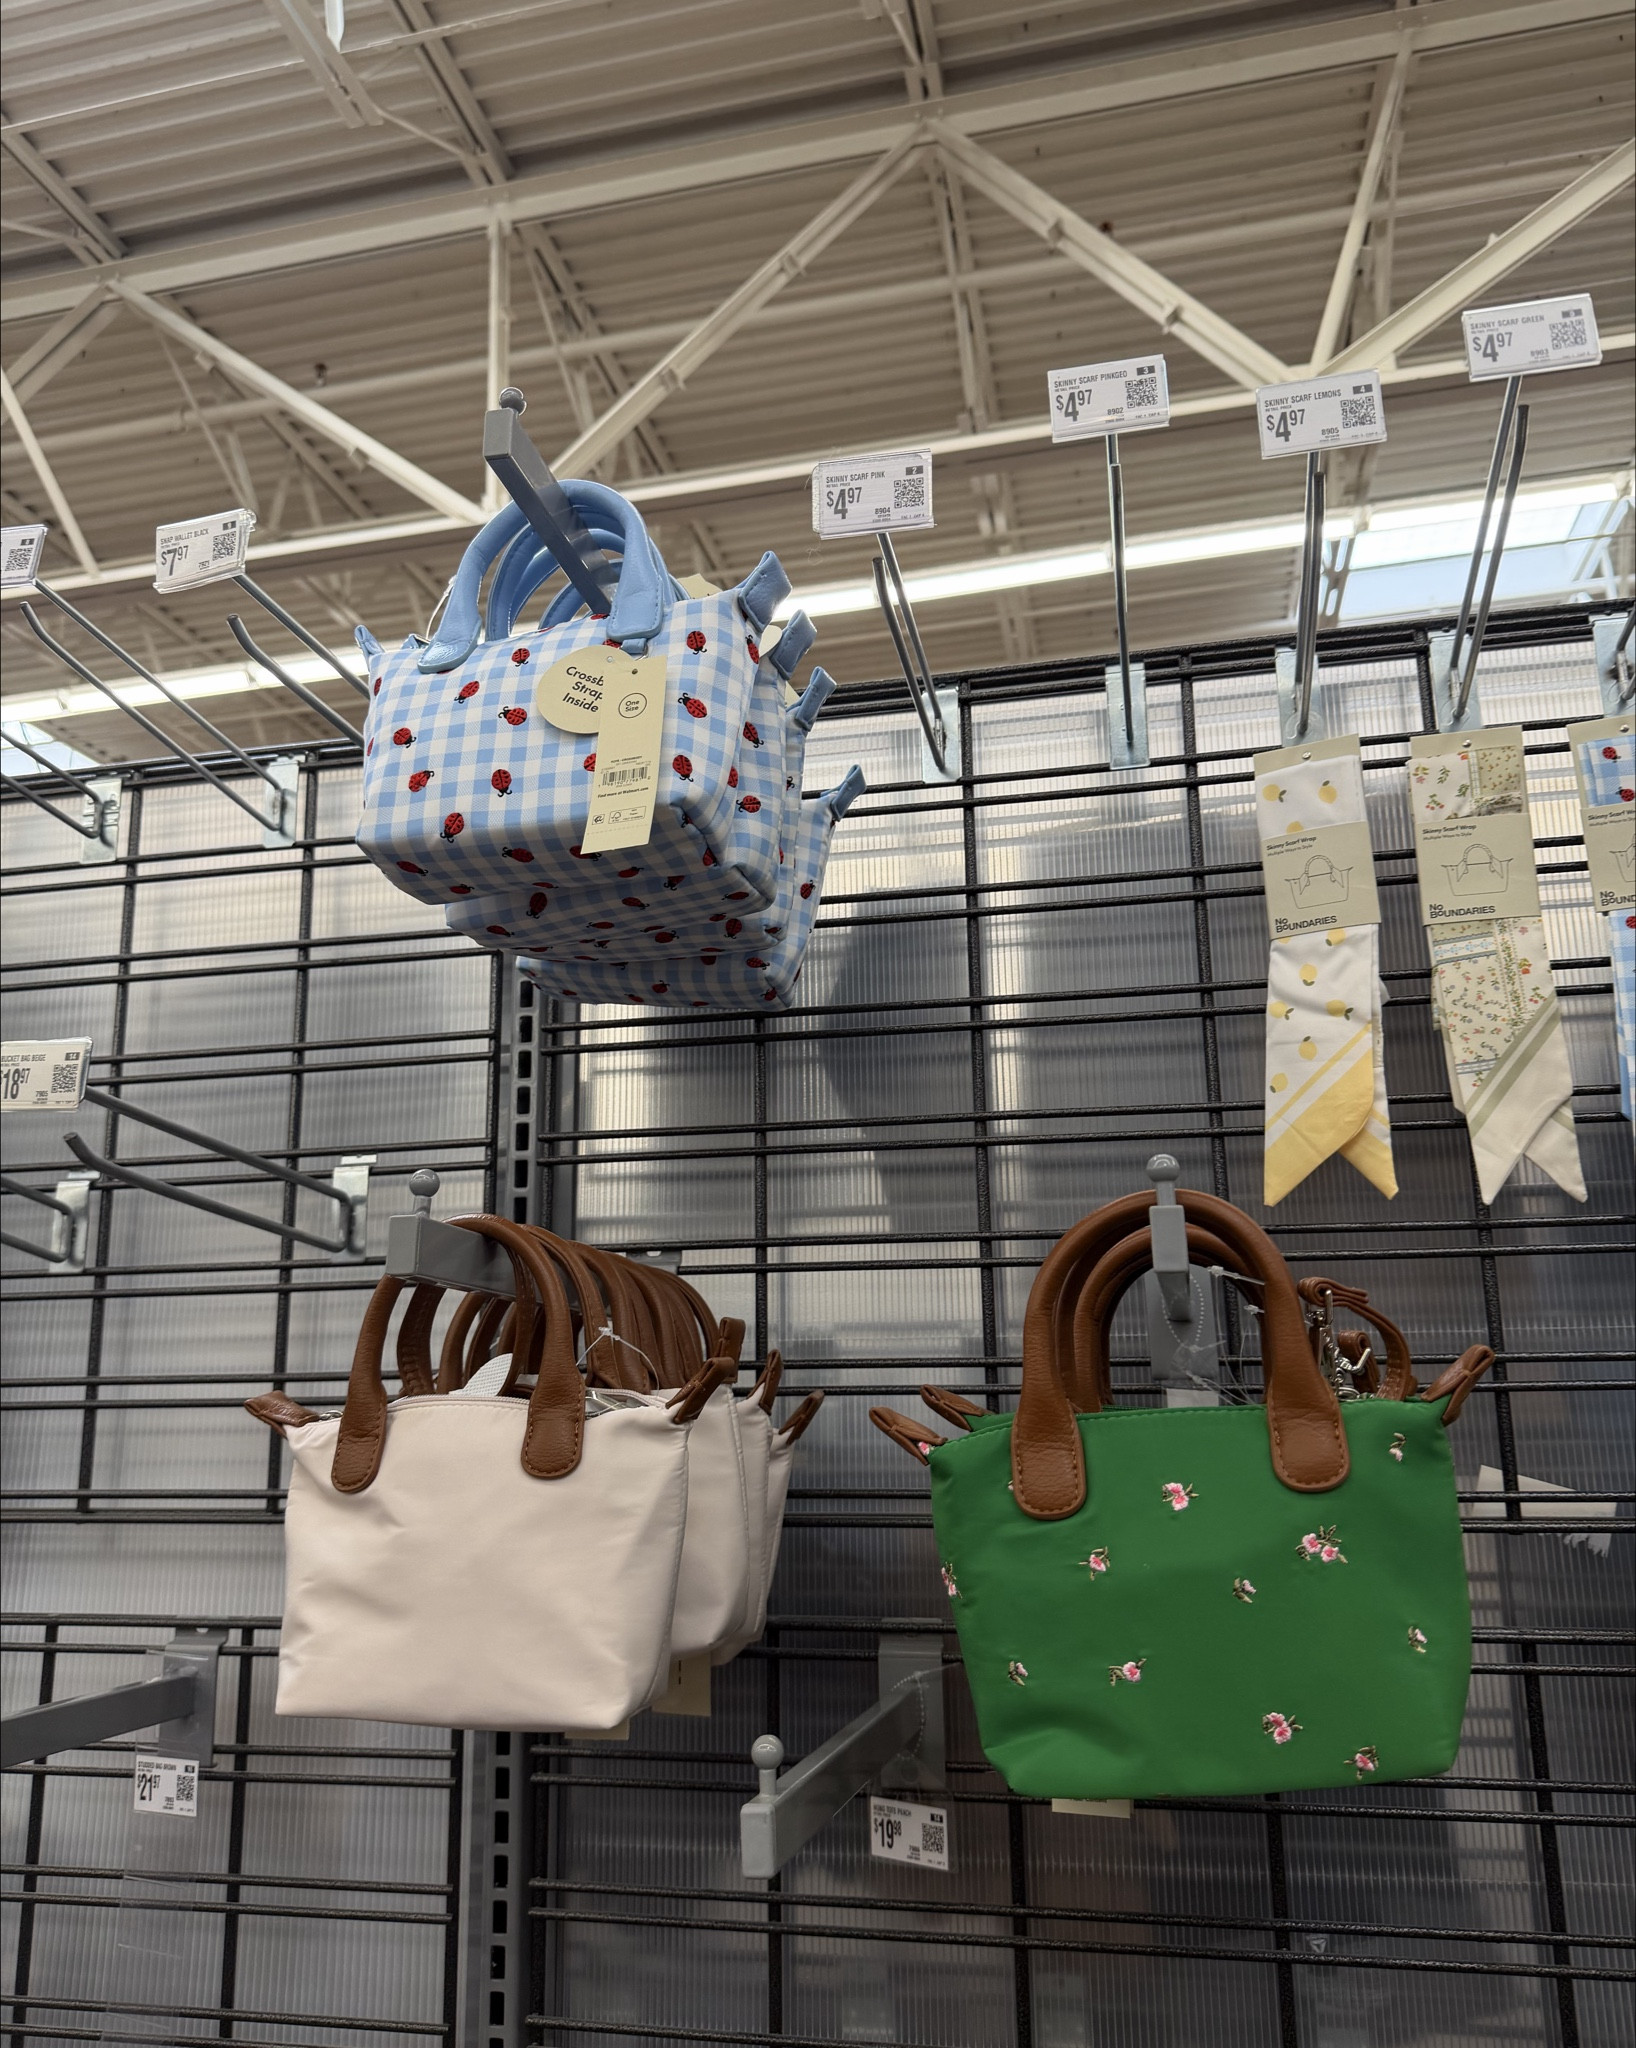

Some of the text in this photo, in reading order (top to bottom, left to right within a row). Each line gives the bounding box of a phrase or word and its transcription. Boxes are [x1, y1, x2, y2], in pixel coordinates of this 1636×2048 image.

[1470, 315, 1545, 330] SKINNY SCARF GREEN
[1054, 378, 1077, 388] SKINNY
[1079, 374, 1099, 384] SCARF
[1264, 389, 1342, 407] SKINNY SCARF LEMONS
[1107, 407, 1124, 415] 8902
[1321, 427, 1340, 435] 8905
[826, 470, 886, 484] SKINNY SCARF PINK
[874, 506, 891, 515] 8904
[174, 532, 193, 542] WALLET
[194, 528, 209, 538] BLACK
[562, 692, 599, 713] Inside
[625, 705, 639, 713] Size
[622, 786, 649, 794] Walmart.com
[1422, 827, 1442, 835] Skinny
[1266, 842, 1285, 851] Skinny
[1285, 838, 1300, 847] Scarf
